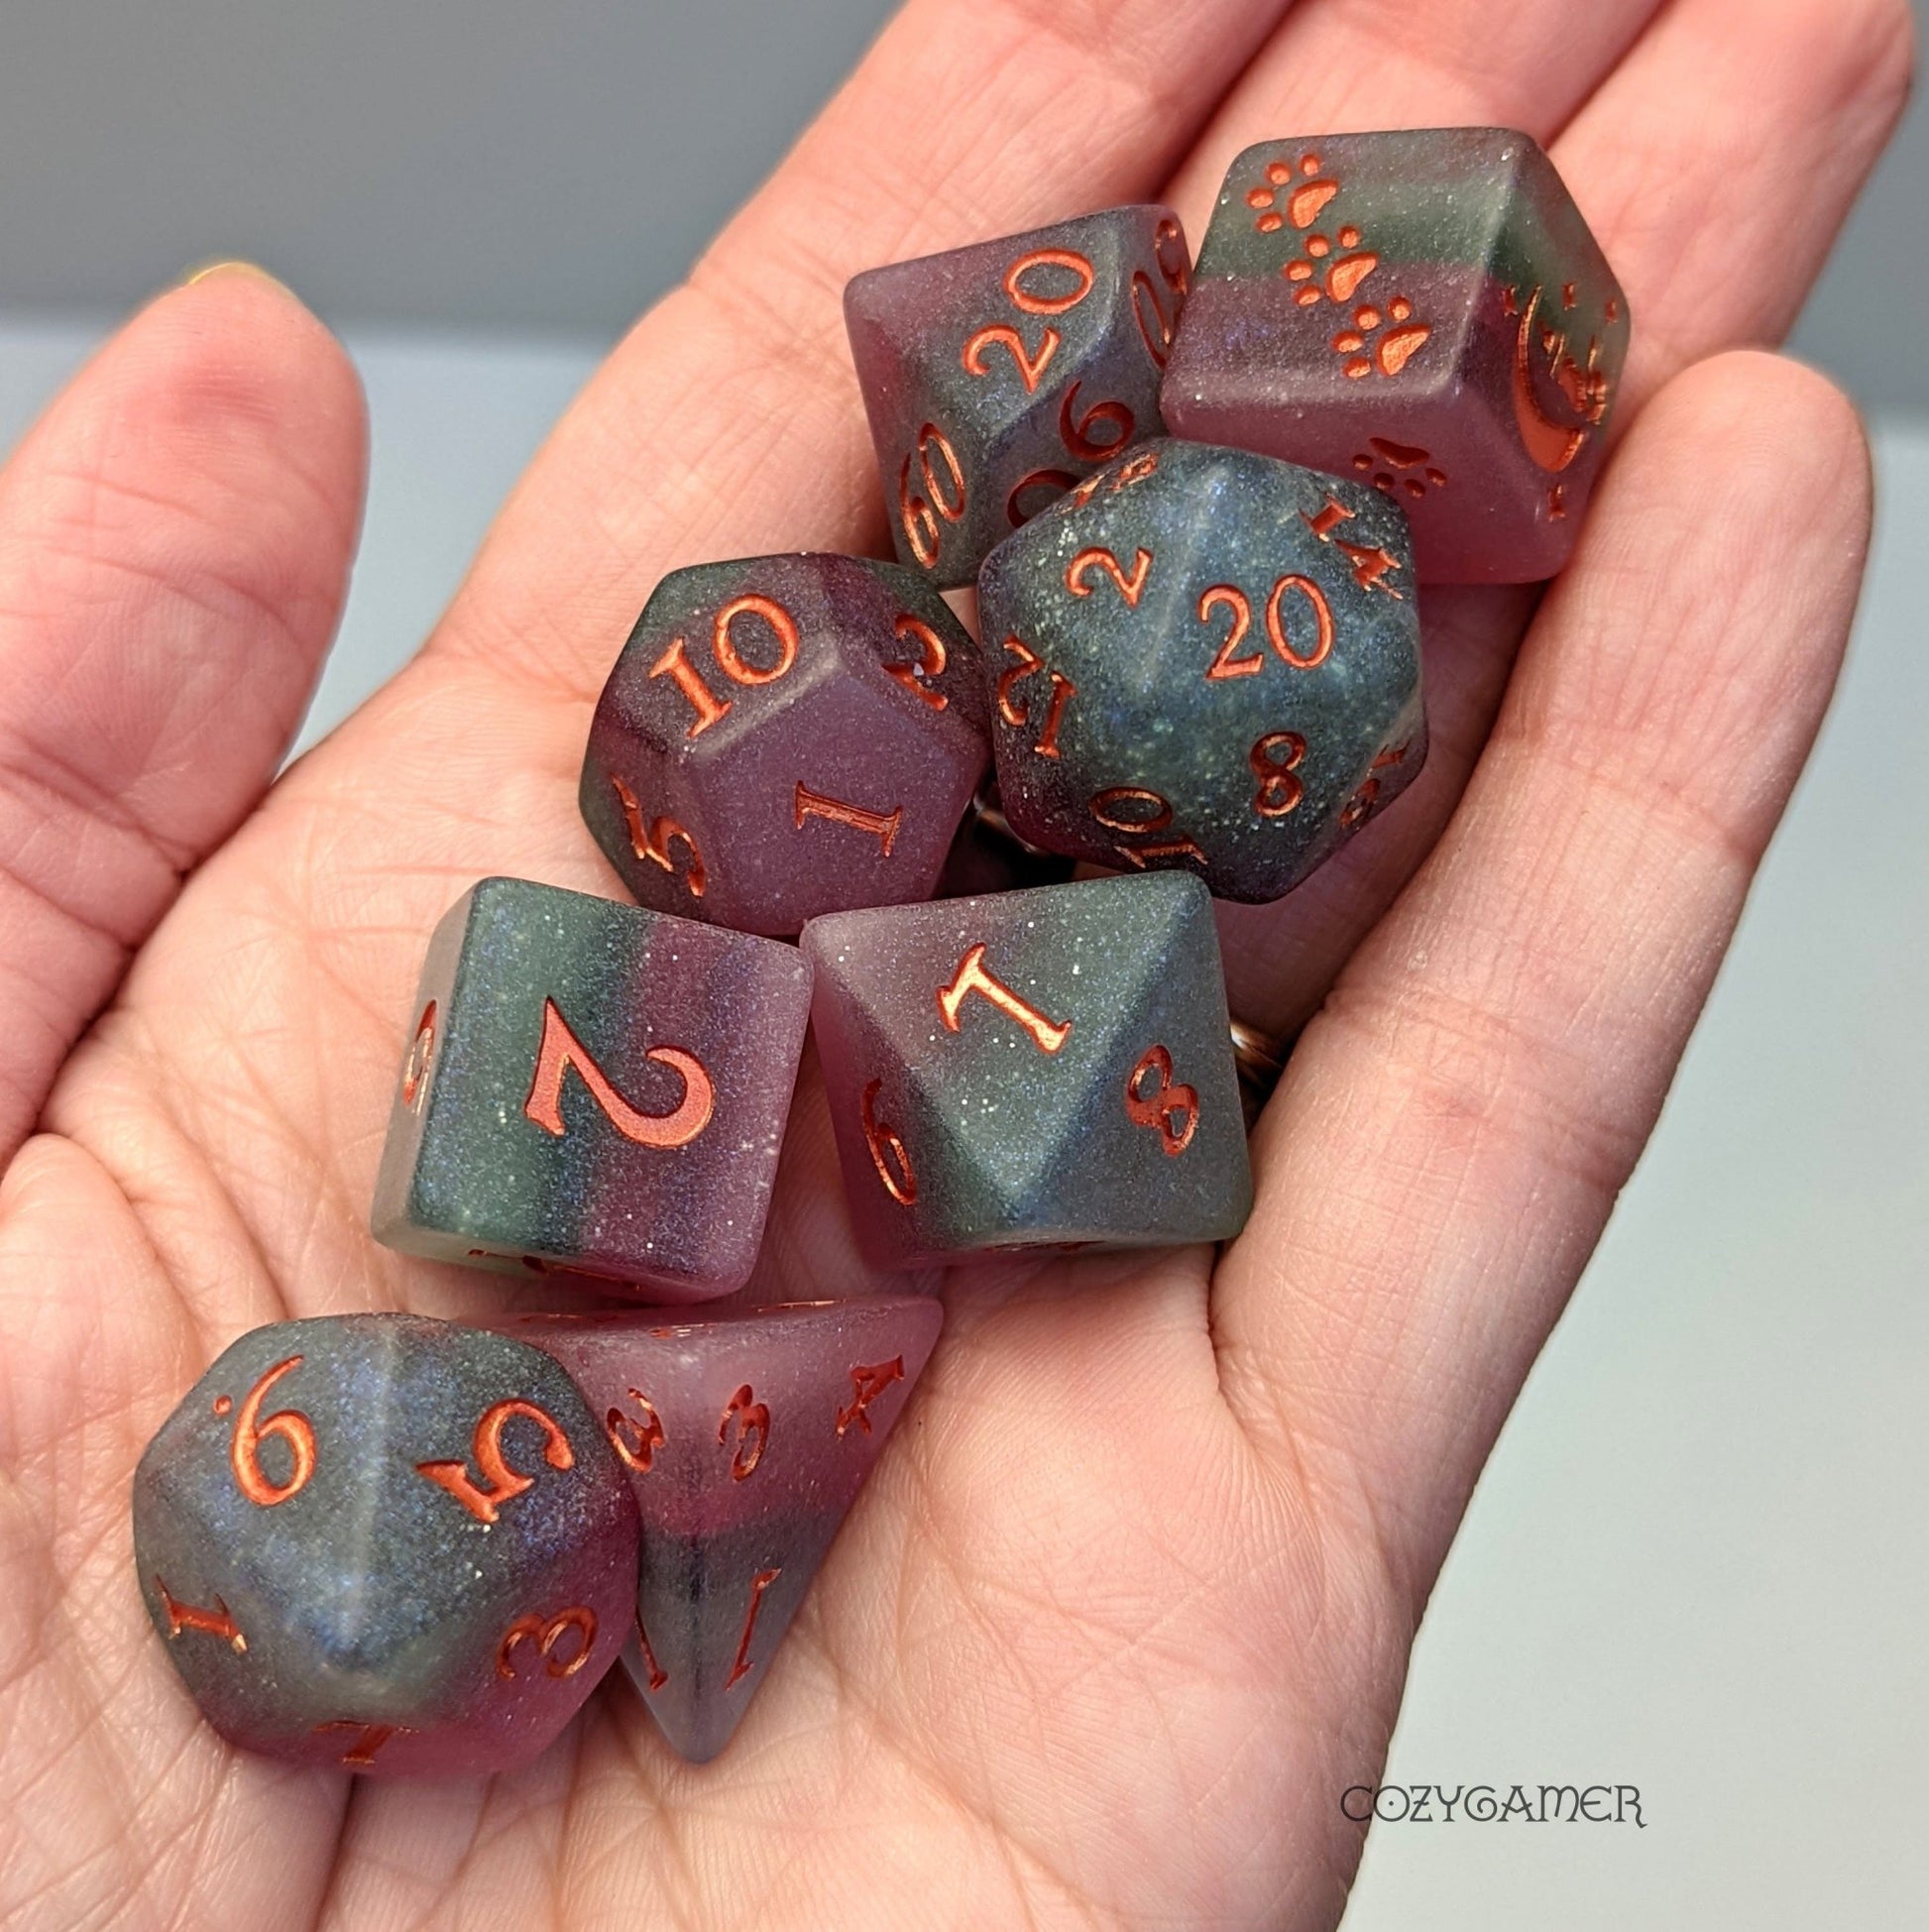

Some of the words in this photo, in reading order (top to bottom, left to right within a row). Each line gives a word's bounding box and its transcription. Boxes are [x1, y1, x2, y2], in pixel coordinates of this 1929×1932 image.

[962, 249, 1094, 395] 20
[899, 422, 965, 569] 60
[1299, 493, 1404, 600] 14
[1065, 546, 1153, 610] 2
[1197, 573, 1334, 682] 20
[649, 595, 800, 739] 10
[997, 634, 1078, 761] 12
[795, 779, 904, 857] 1
[1090, 786, 1208, 868] 10
[1250, 732, 1306, 819] 8
[611, 773, 706, 897] 5
[524, 995, 717, 1150] 2
[1125, 1044, 1199, 1158] 8
[723, 1384, 770, 1482] 3
[836, 1354, 905, 1440] 4
[415, 1398, 575, 1523] 5
[156, 1574, 248, 1654] 1
[499, 1607, 597, 1680] 3
